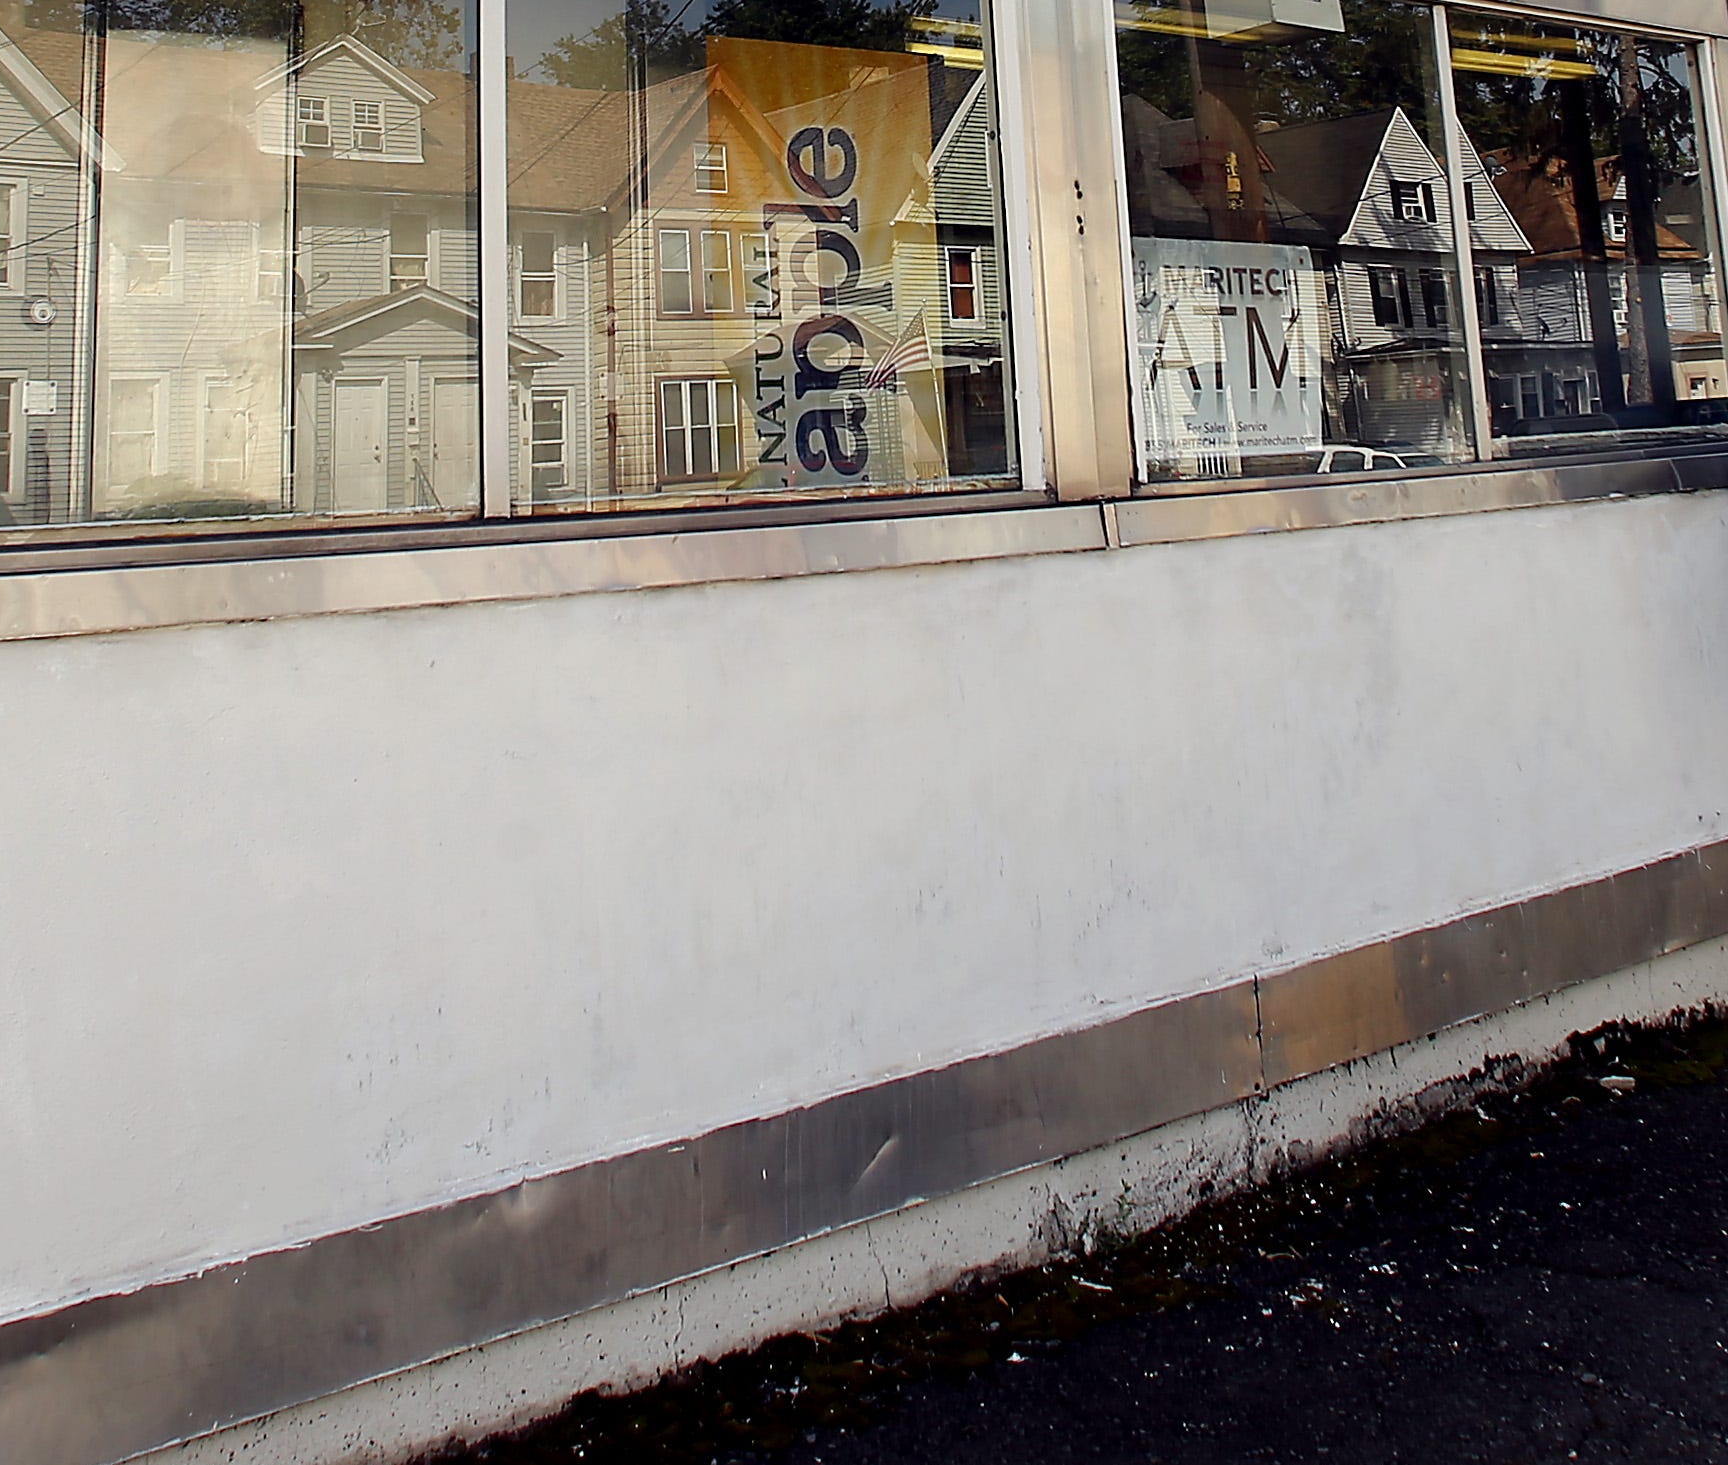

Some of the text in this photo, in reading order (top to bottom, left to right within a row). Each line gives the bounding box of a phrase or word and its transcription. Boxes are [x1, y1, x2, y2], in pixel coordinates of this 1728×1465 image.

[1163, 265, 1298, 297] MARITECH
[753, 238, 788, 466] NATURAL
[1149, 304, 1307, 391] ATM
[1186, 422, 1202, 433] For
[1203, 421, 1226, 434] Sales
[1237, 420, 1268, 433] Service
